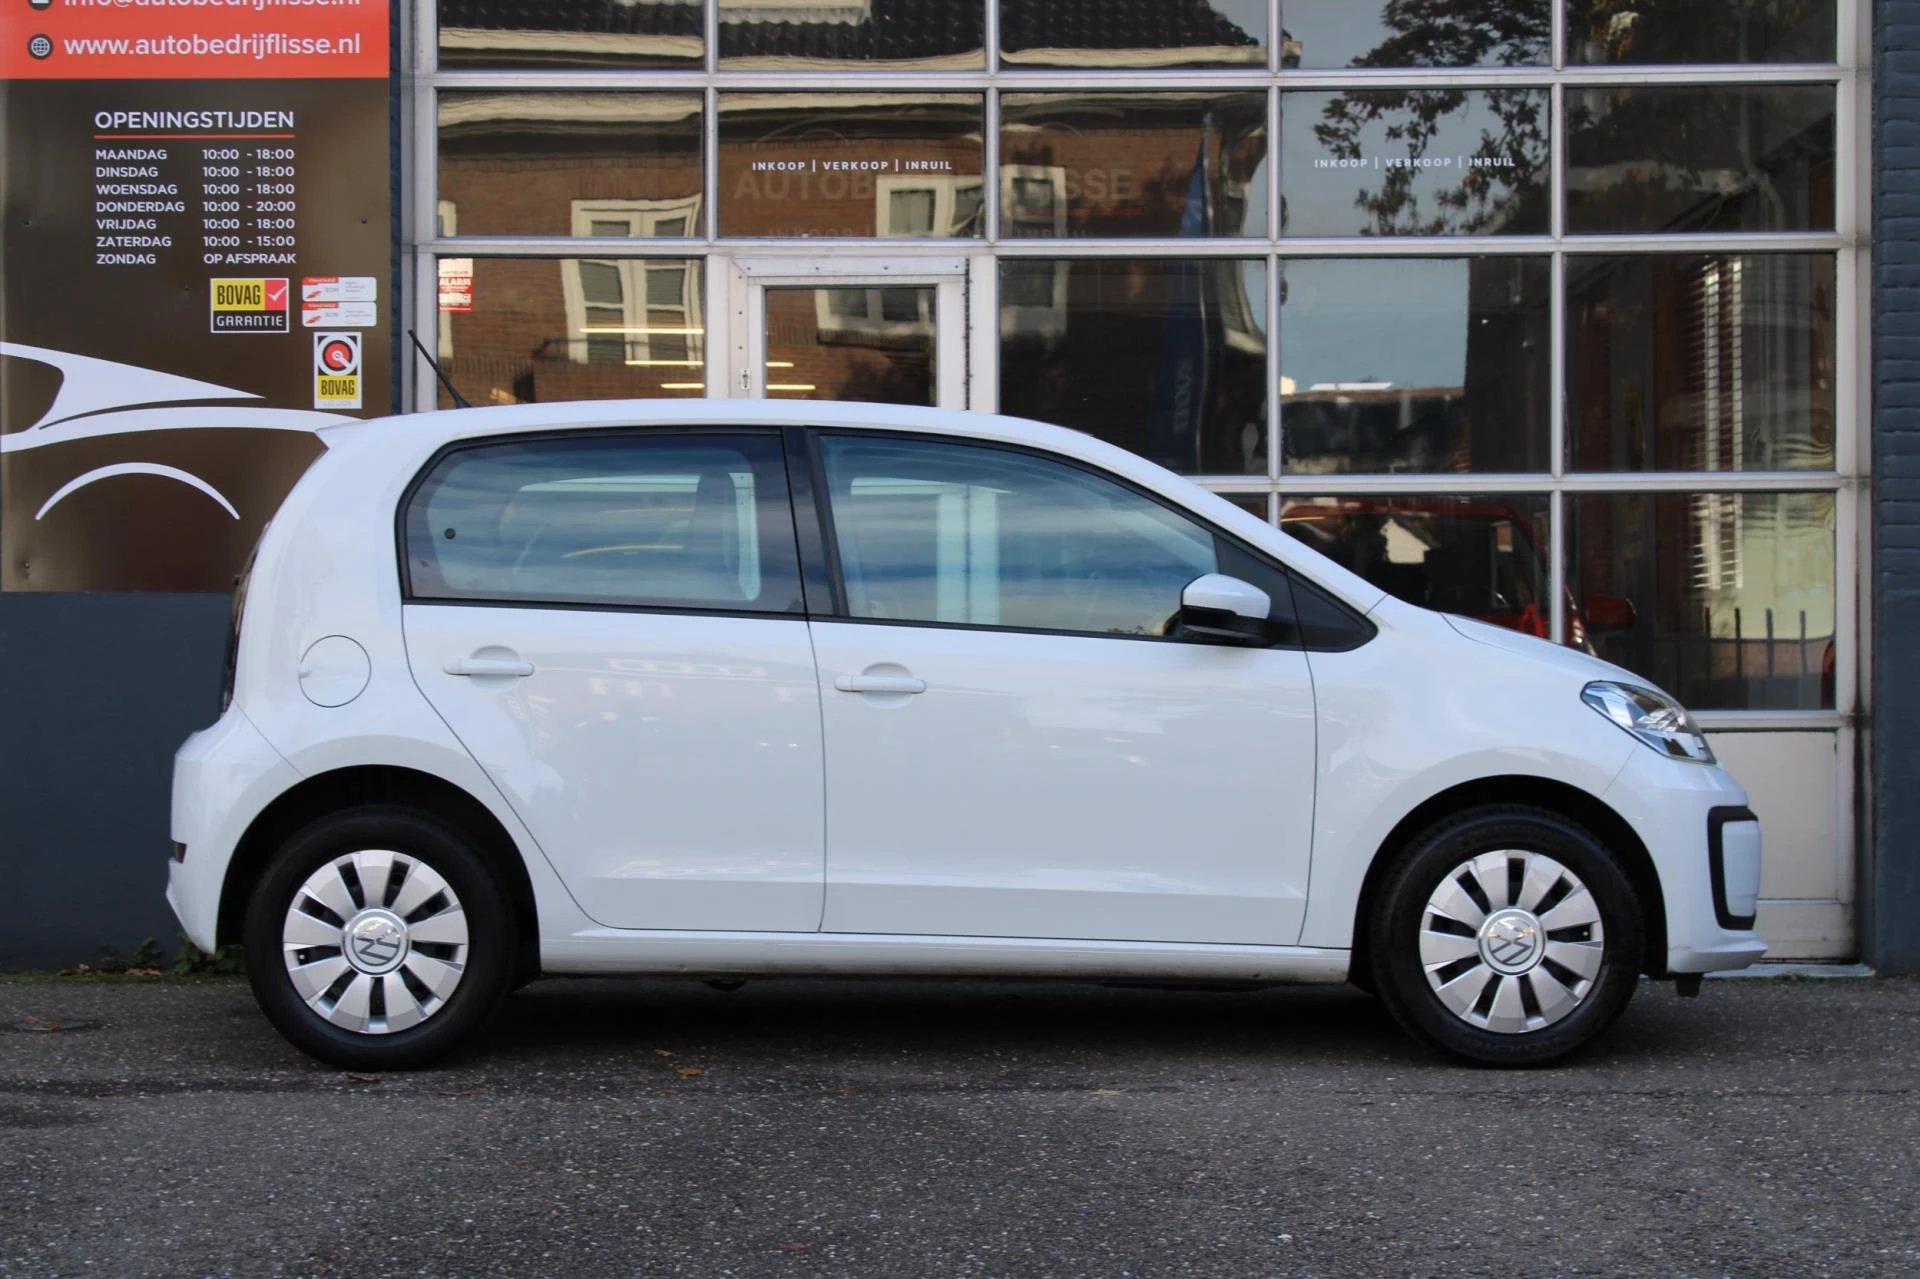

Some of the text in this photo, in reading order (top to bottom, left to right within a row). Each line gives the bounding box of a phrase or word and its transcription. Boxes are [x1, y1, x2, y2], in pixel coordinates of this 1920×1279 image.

[63, 33, 361, 60] www.autobedrijflisse.nl
[94, 111, 294, 129] OPENINGSTIJDEN
[95, 149, 168, 160] MAANDAG
[202, 148, 240, 160] 10:00
[255, 148, 295, 160] 18:00
[752, 161, 806, 171] INKOOP
[822, 161, 889, 171] VERKOOP
[905, 160, 952, 170] INRUIL
[1314, 158, 1368, 169] INKOOP
[1385, 157, 1452, 168] VERKOOP
[1469, 156, 1516, 167] INRUIL
[95, 166, 159, 178] DINSDAG
[202, 166, 240, 178] 10:00
[255, 166, 295, 177] 18:00
[95, 183, 178, 195] WOENSDAG
[202, 183, 240, 195] 10:00
[255, 183, 295, 195] 18:00
[96, 201, 185, 213] DONDERDAG
[202, 200, 240, 212] 10:00
[256, 200, 296, 212] 20:00
[95, 218, 157, 230] VRIJDAG
[202, 218, 240, 230] 10:00
[256, 218, 296, 229] 18:00
[96, 236, 172, 248] ZATERDAG
[202, 235, 241, 247] 10:00
[256, 235, 296, 247] 15:00
[96, 253, 297, 265] ZONDAG OP AFSPRAAK
[217, 284, 261, 306] BOVAG
[216, 315, 284, 327] GARANTIE
[321, 379, 356, 396] BOVAG
